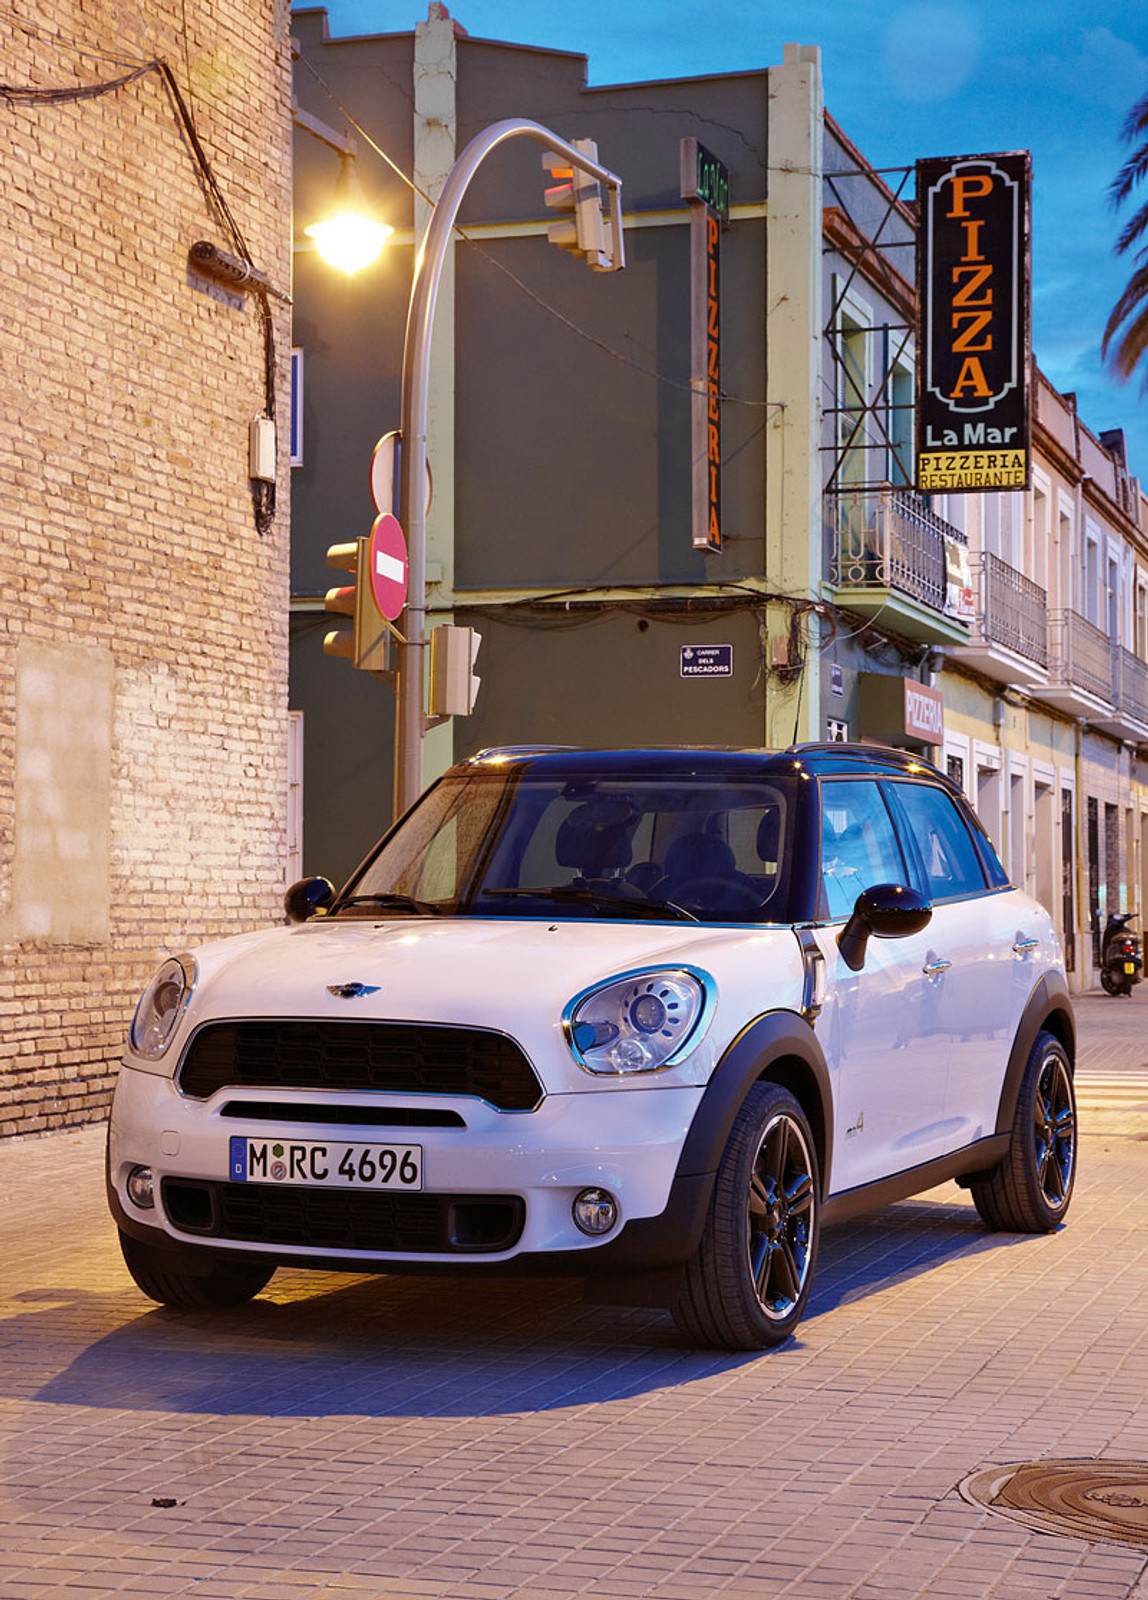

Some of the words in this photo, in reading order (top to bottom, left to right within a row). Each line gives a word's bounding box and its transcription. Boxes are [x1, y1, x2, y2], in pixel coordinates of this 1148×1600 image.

[946, 174, 994, 398] PIZZA
[707, 215, 721, 546] PIZZERIA
[926, 425, 958, 447] La
[964, 423, 1018, 445] Mar
[920, 454, 1023, 472] PIZZERIA
[920, 470, 1023, 489] RESTAURANTE
[683, 665, 729, 673] PESCADORS
[906, 689, 943, 735] PIZZERIA
[337, 1147, 418, 1185] 4696
